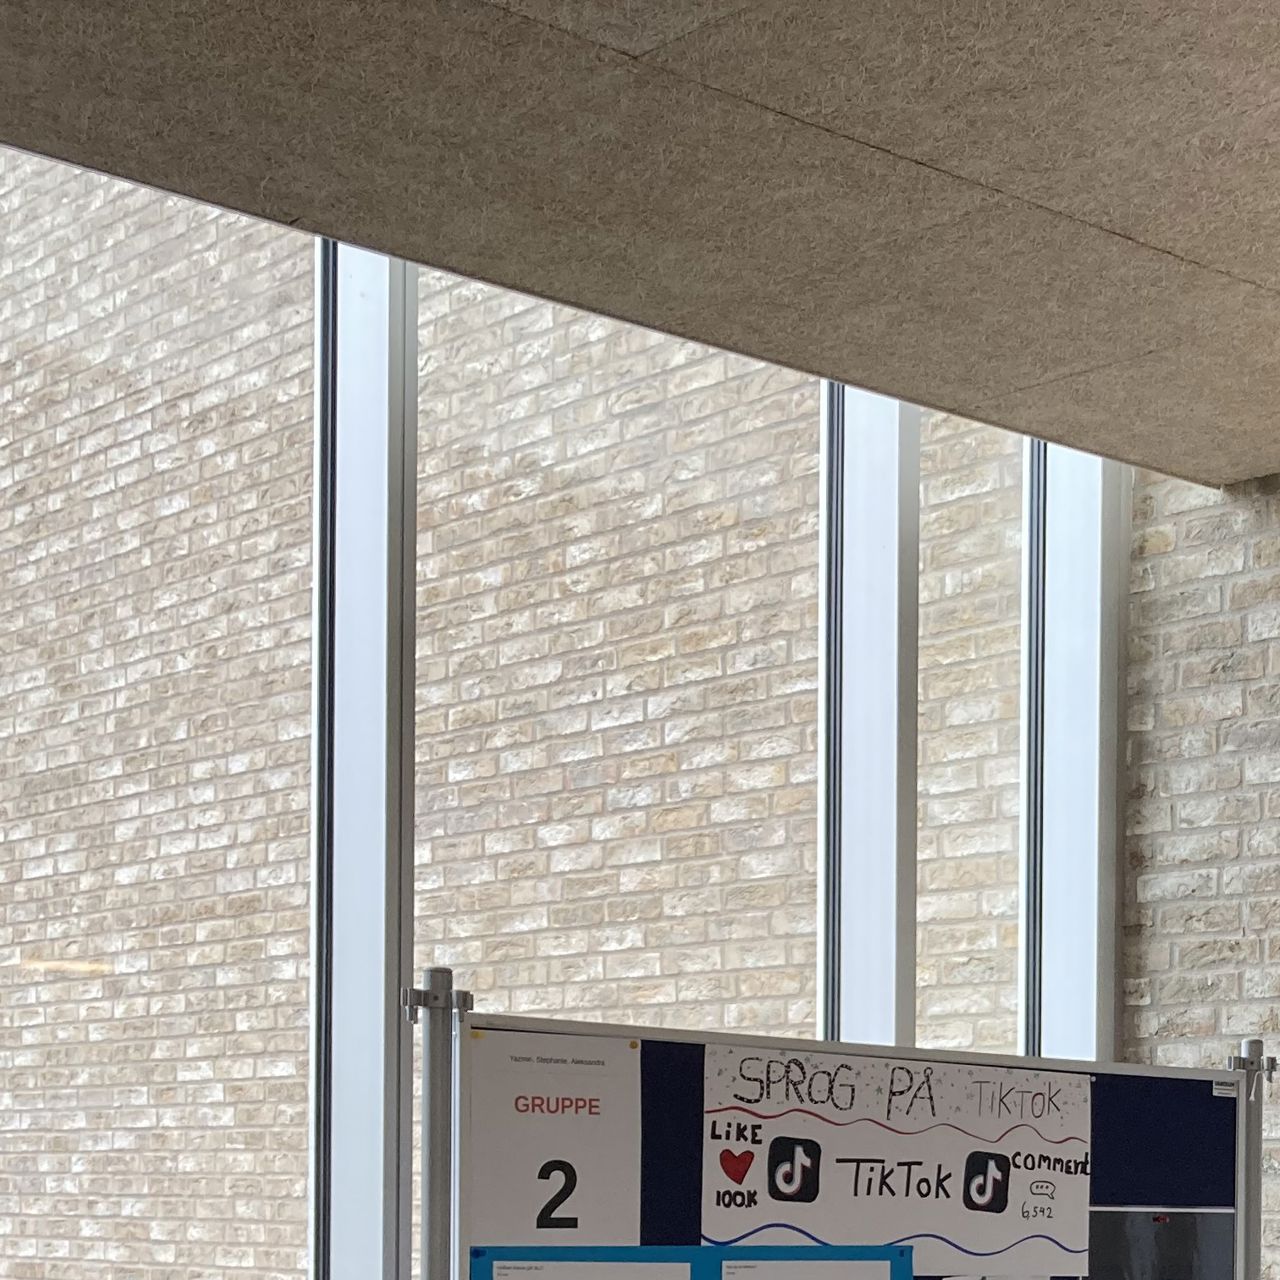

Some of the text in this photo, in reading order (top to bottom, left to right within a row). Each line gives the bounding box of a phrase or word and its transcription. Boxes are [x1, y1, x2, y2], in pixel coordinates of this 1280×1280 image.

[514, 1095, 601, 1116] GRUPPE
[733, 1057, 855, 1111] SPROG
[886, 1066, 936, 1121] PÅ
[536, 1159, 579, 1229] 2
